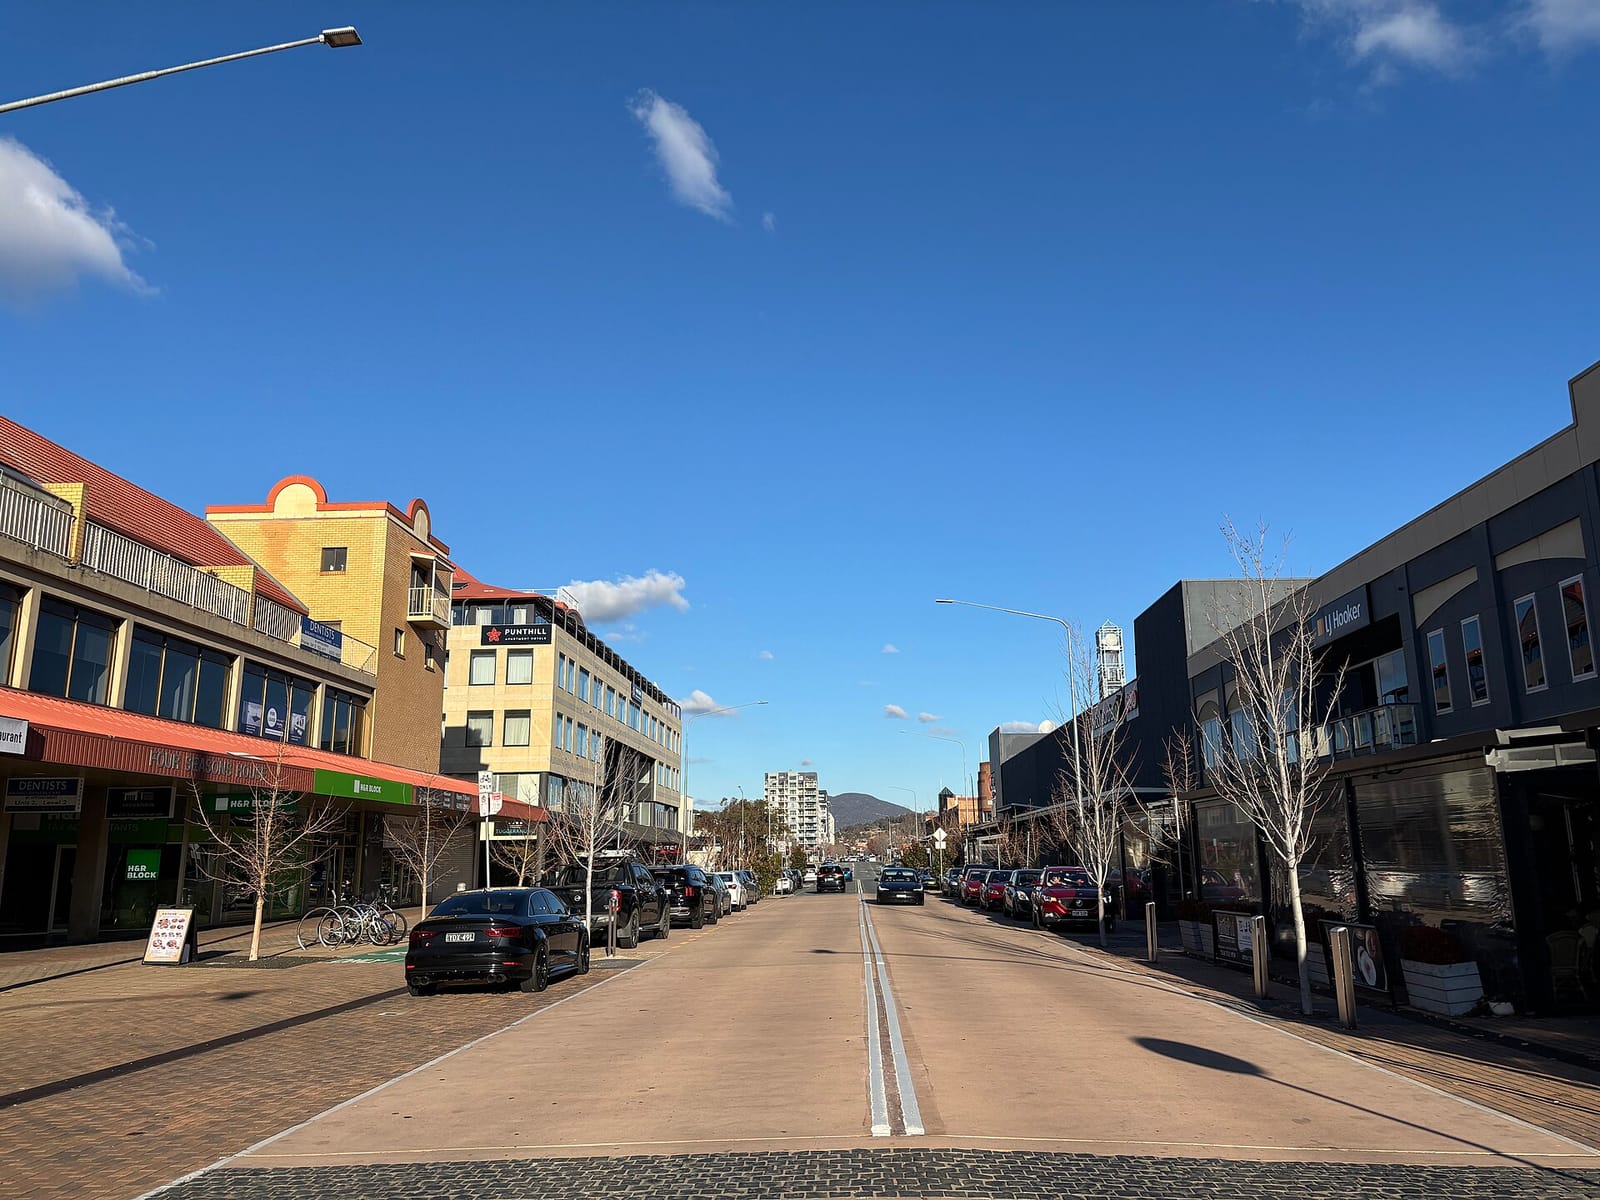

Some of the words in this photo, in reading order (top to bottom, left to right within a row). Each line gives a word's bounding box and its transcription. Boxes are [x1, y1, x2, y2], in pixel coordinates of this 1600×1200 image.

[1325, 614, 1332, 636] LJ
[1333, 603, 1360, 629] Hooker
[310, 620, 336, 640] DENTISTS
[504, 628, 547, 636] PUNTHILL
[148, 748, 181, 770] FOUR
[184, 754, 232, 777] SEASONS
[235, 762, 267, 780] HOUSE
[18, 780, 68, 791] DENTISTS
[230, 799, 250, 808] H&R
[127, 864, 147, 872] H&R
[127, 871, 157, 879] BLOCK
